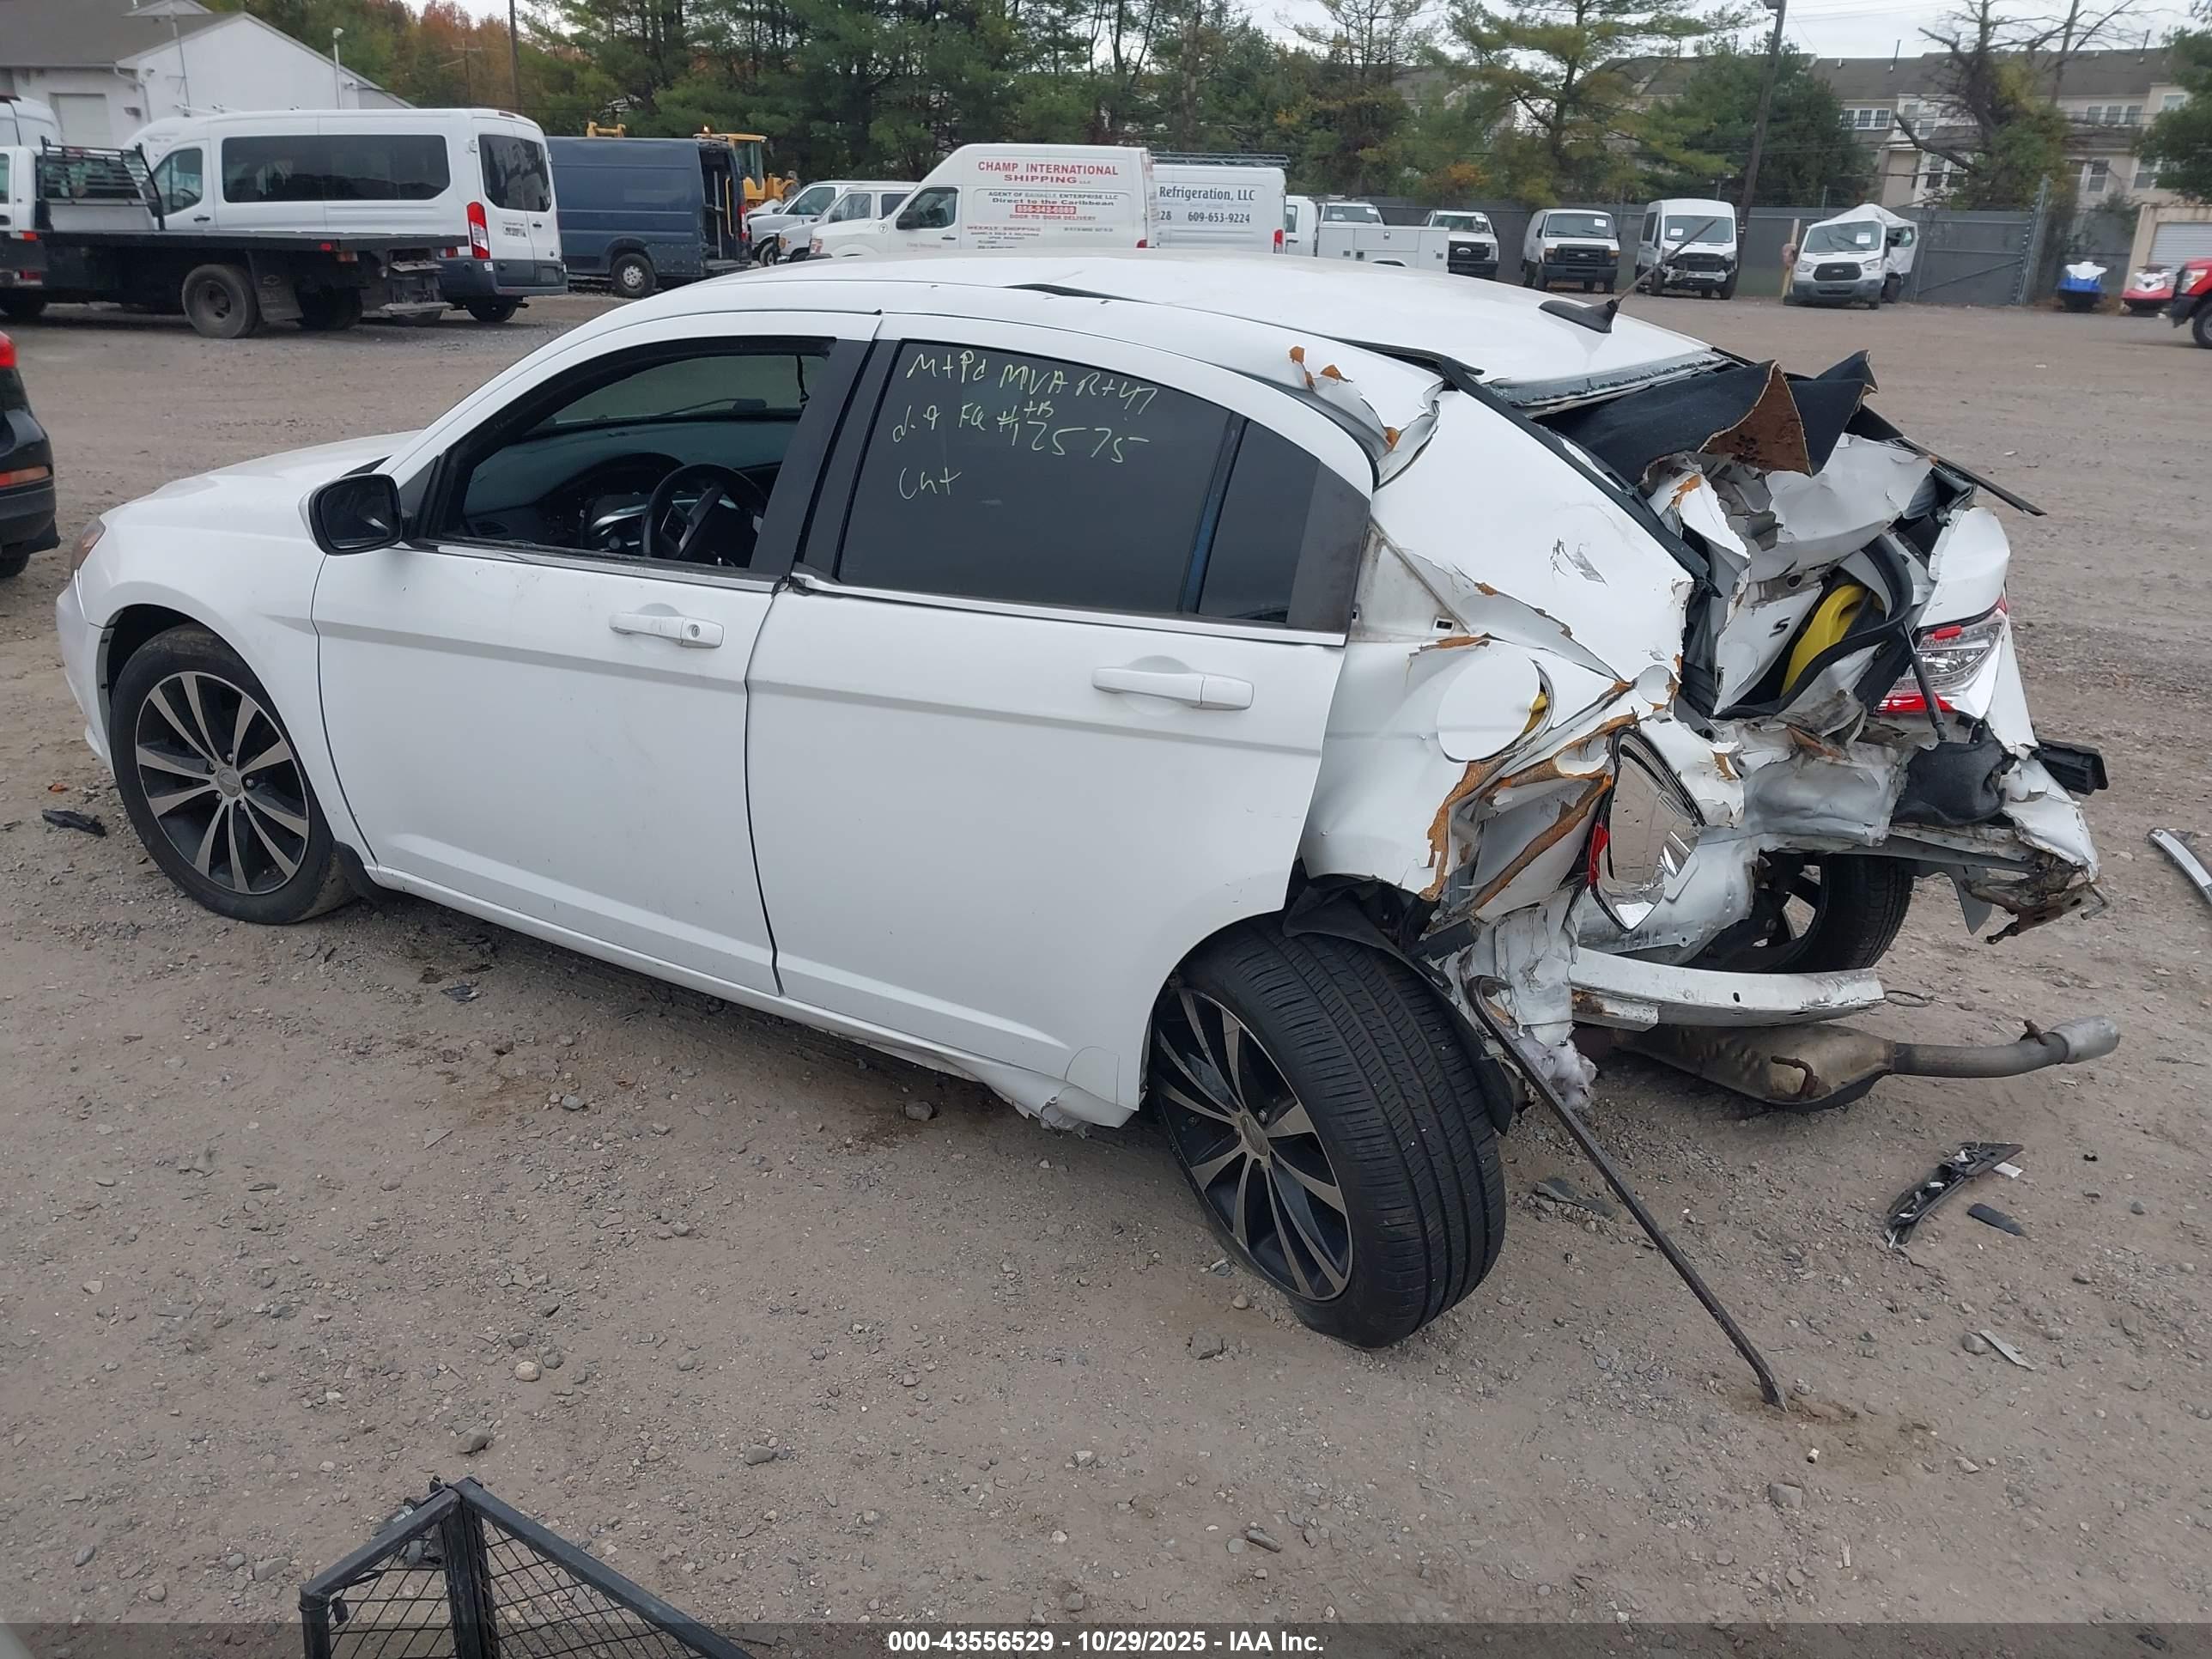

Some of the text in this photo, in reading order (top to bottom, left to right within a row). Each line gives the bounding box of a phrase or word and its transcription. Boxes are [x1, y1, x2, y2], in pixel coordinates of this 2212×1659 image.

[978, 161, 1119, 175] CHAMP INTERNATIONAL
[1004, 174, 1078, 184] SHIPPING
[1159, 186, 1256, 201] Refrigeration, LLC
[1188, 212, 1250, 223] 609-653-9224
[999, 364, 1068, 395] MVA
[1769, 617, 1792, 637] S
